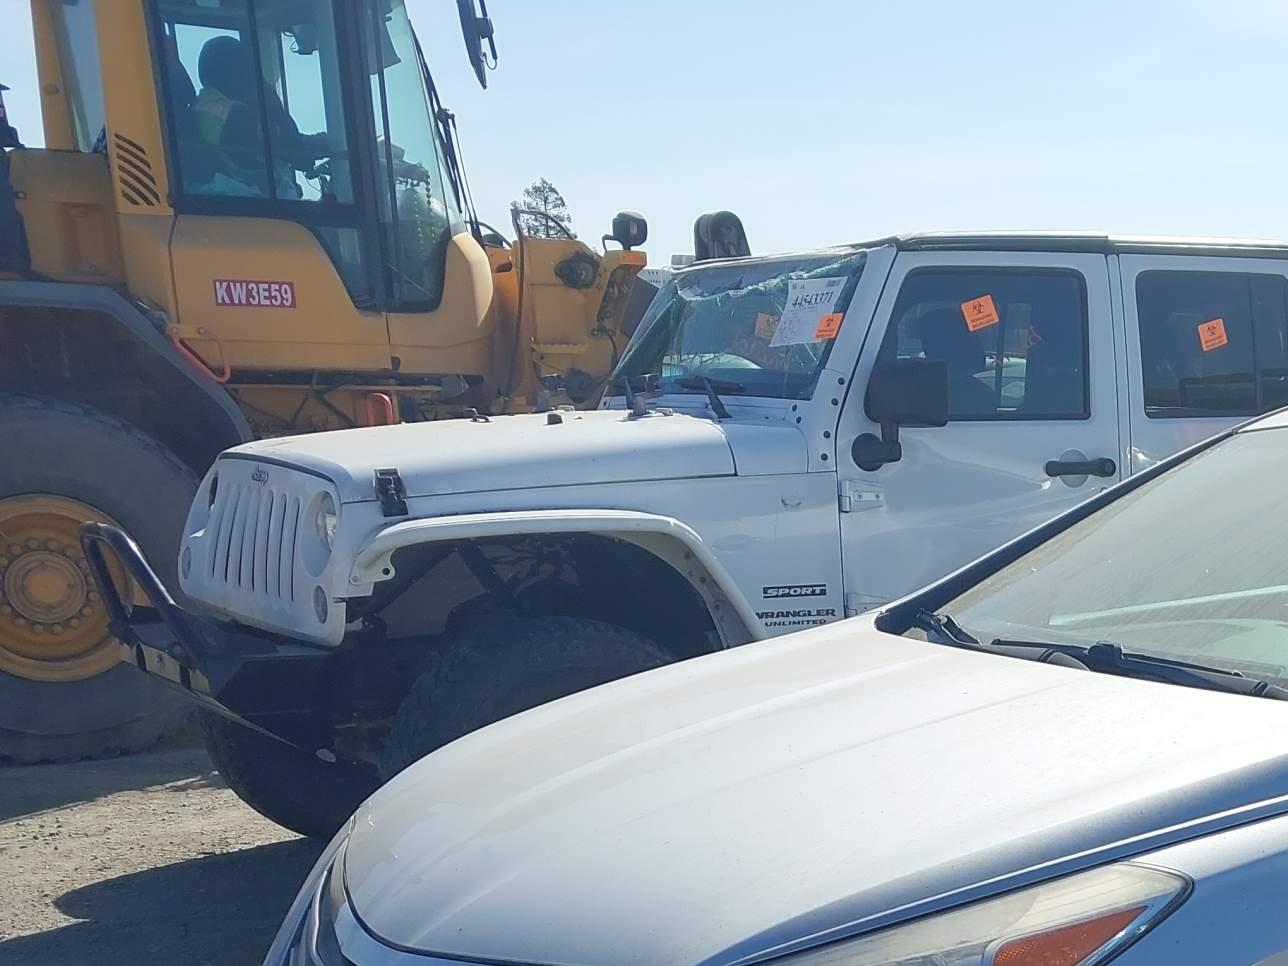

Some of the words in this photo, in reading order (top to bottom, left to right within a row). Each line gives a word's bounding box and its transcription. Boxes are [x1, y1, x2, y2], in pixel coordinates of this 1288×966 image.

[215, 281, 292, 306] KW3E59
[765, 586, 826, 597] SPORT
[764, 619, 827, 628] UNLIMITED
